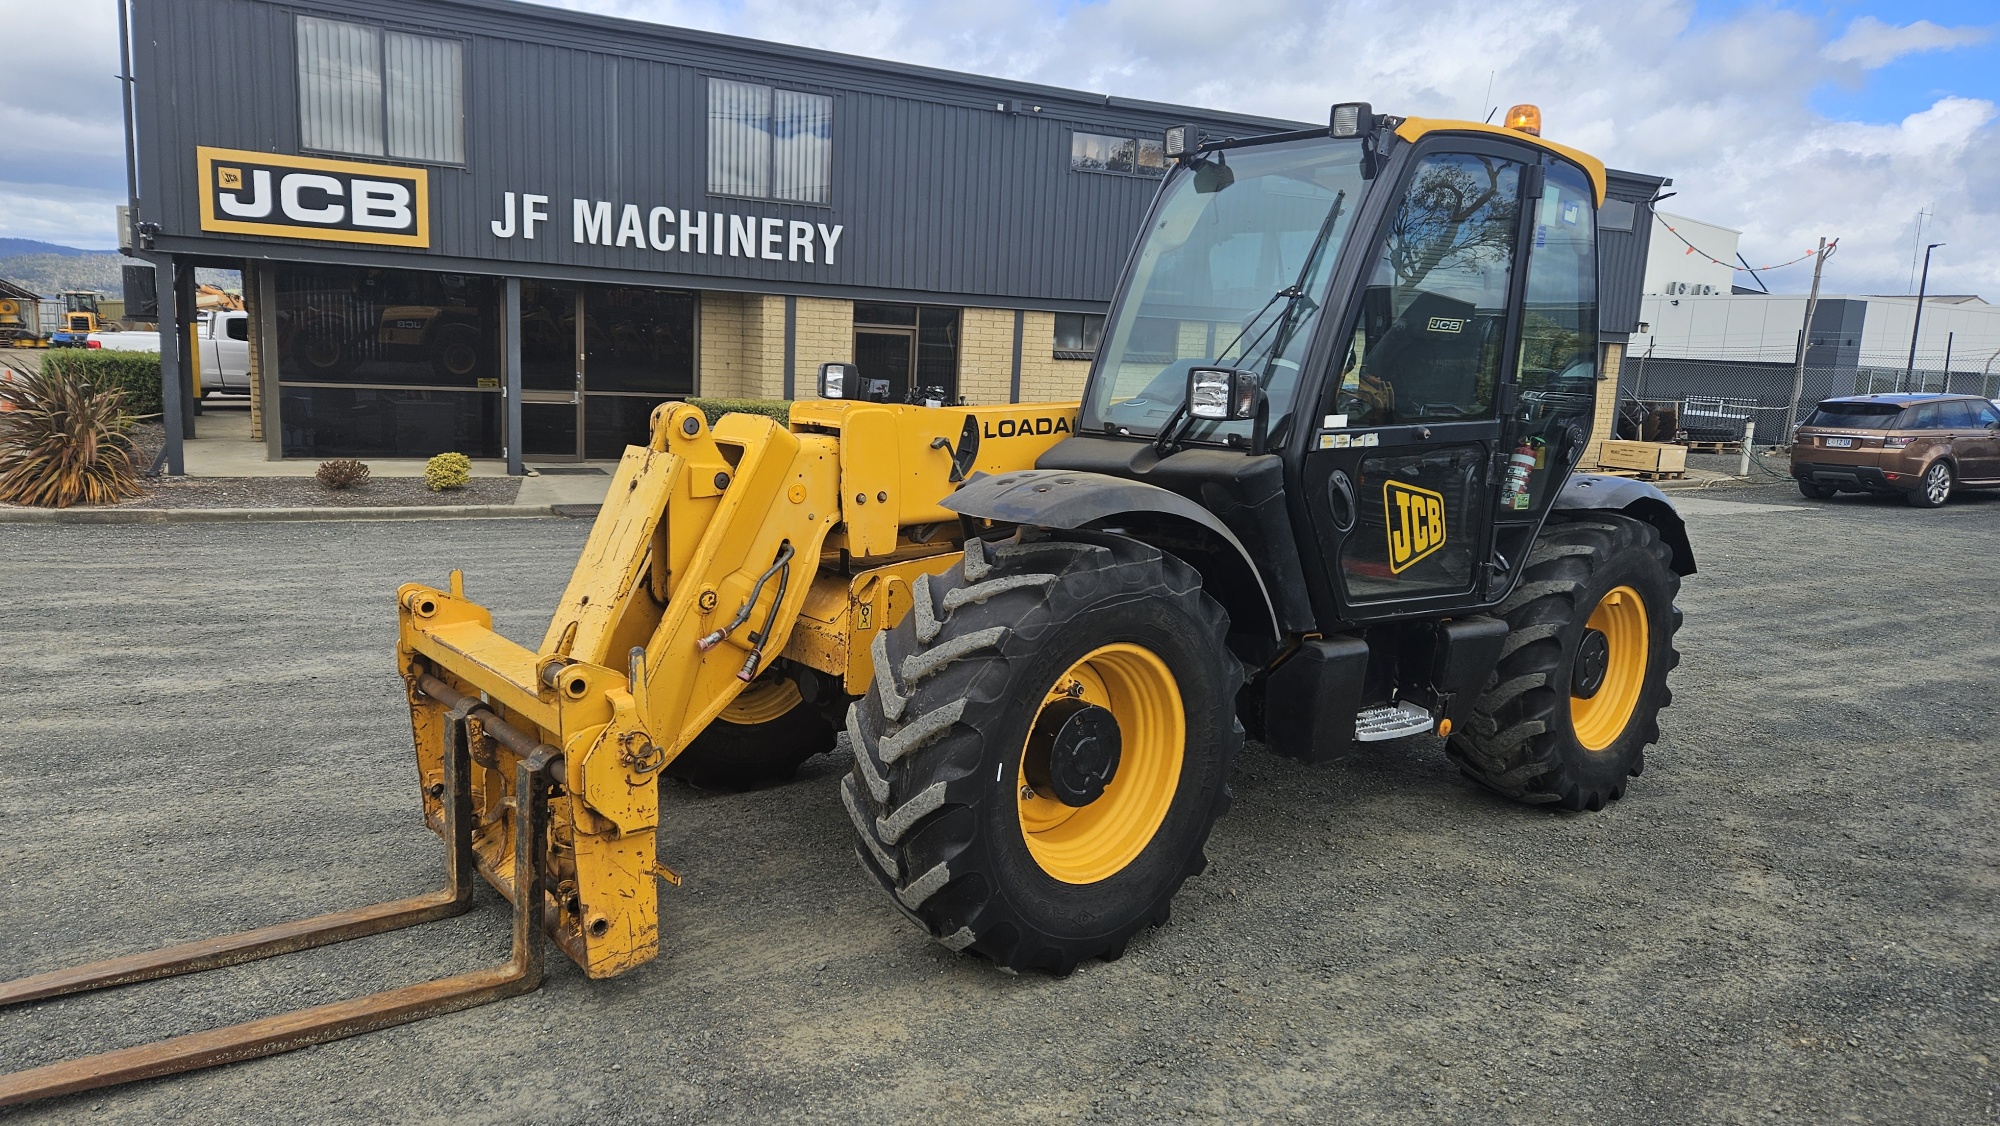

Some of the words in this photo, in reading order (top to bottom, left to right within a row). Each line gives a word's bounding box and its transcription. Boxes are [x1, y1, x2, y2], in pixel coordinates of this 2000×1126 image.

[218, 169, 412, 229] JCB
[491, 191, 549, 240] JF
[573, 198, 844, 265] MACHINERY
[1430, 320, 1461, 331] JCB
[1393, 490, 1442, 563] JCB
